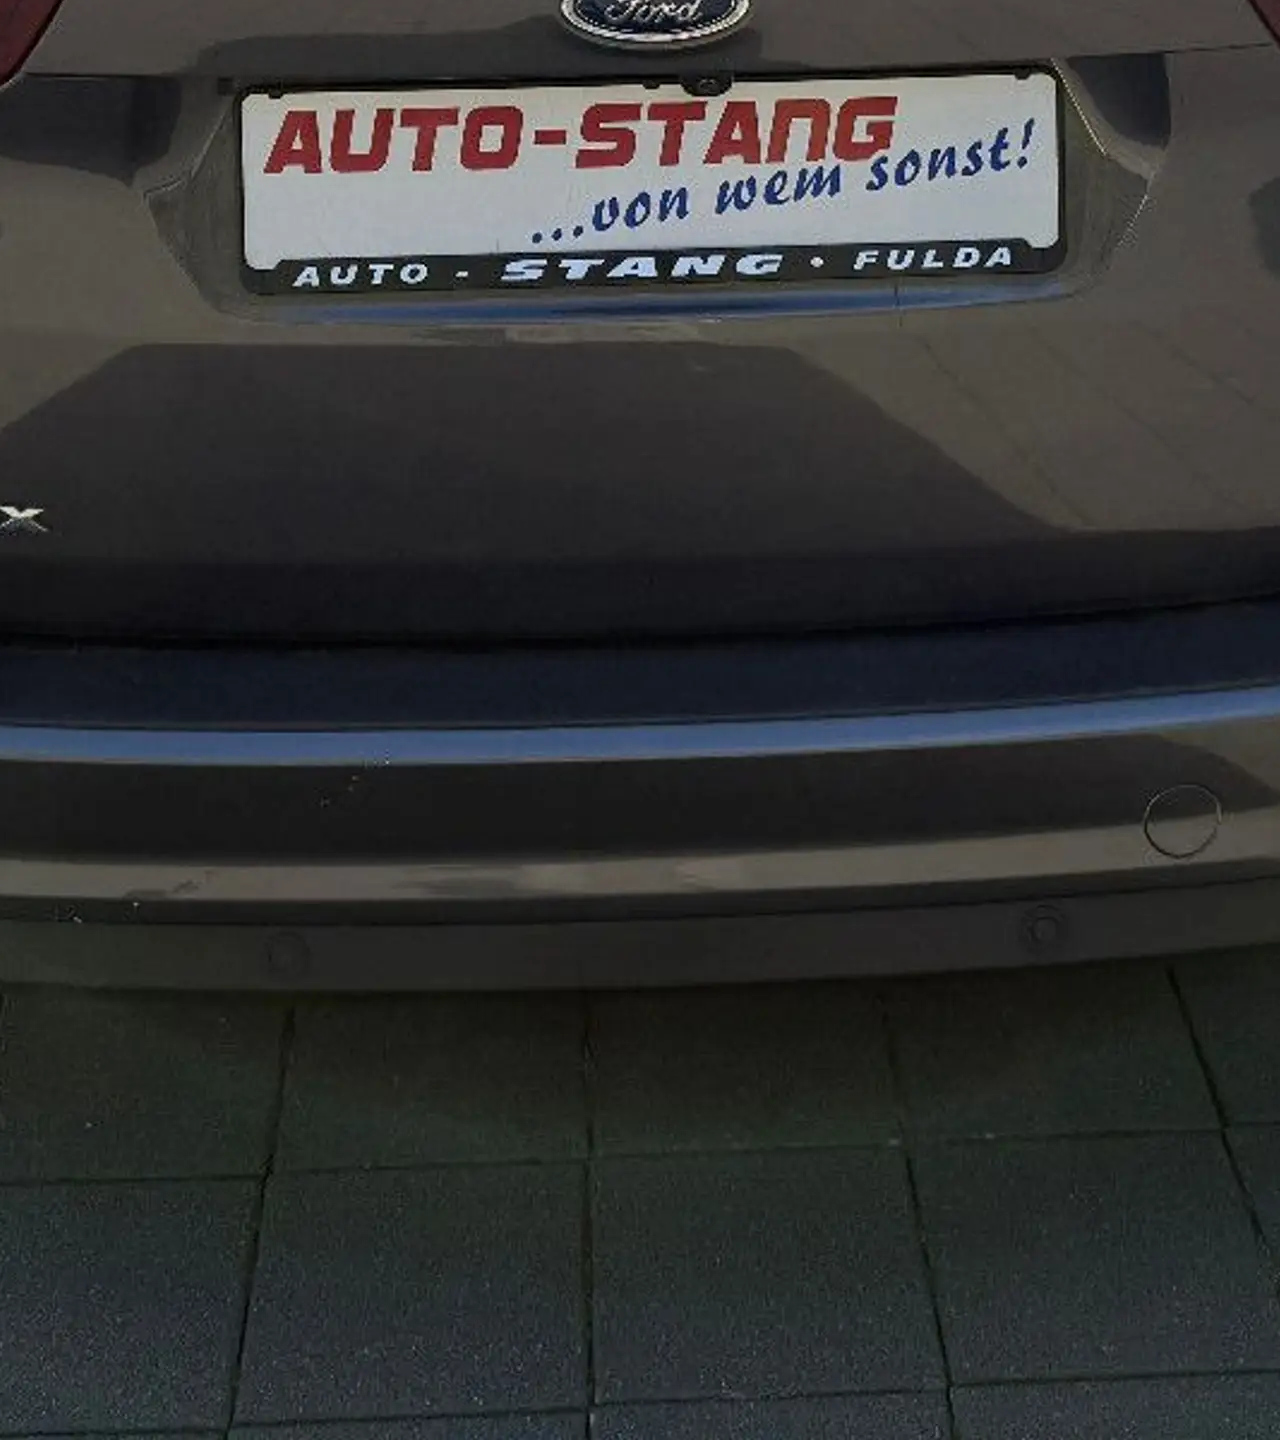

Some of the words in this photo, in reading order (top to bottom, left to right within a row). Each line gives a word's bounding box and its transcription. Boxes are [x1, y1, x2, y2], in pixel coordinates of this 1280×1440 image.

[263, 96, 898, 174] AUTO-STANG
[715, 165, 842, 215] wem
[865, 117, 1035, 192] sonst!
[292, 263, 428, 288] AUTO
[500, 254, 784, 282] STANG
[853, 247, 1013, 272] FULDA
